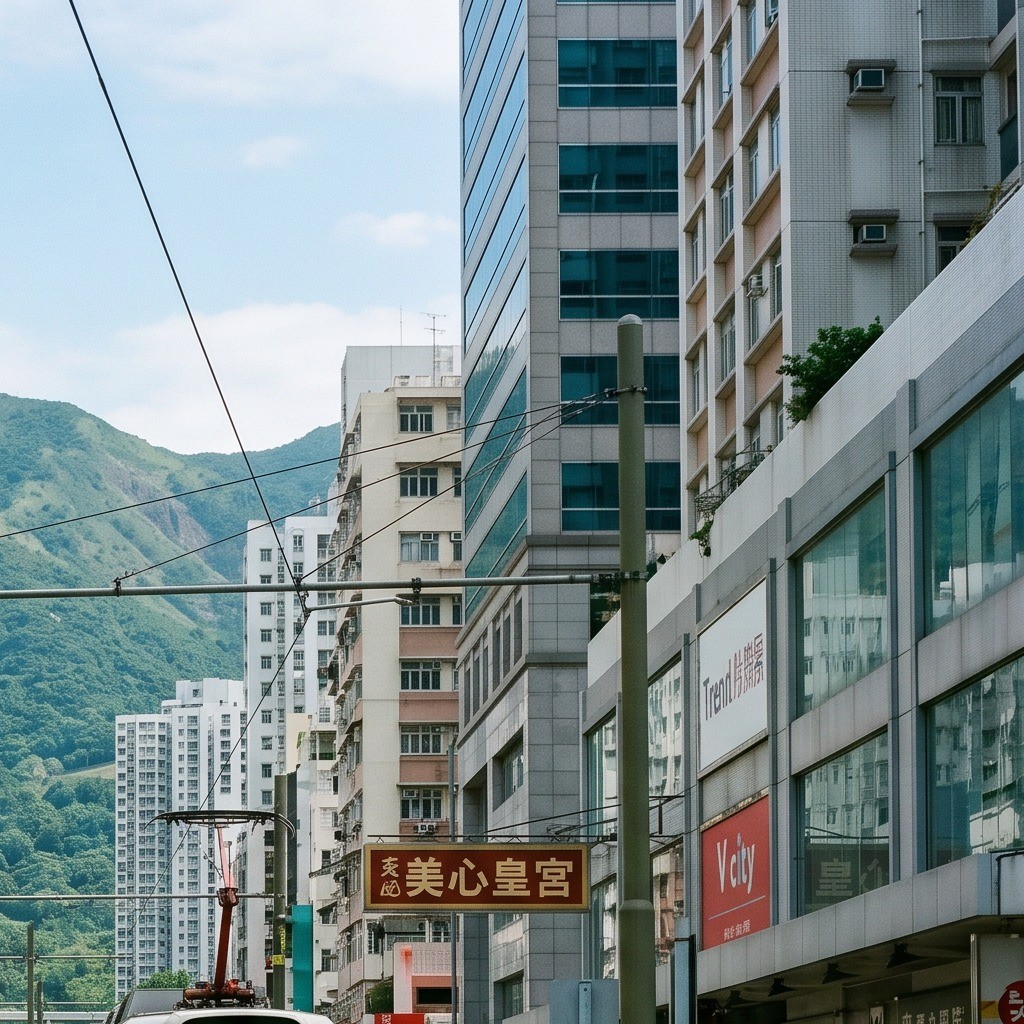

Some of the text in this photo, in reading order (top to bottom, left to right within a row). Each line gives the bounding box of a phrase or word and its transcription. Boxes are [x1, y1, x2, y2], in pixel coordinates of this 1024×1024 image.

[703, 658, 732, 721] Trend
[405, 856, 574, 898] 美心皇宮
